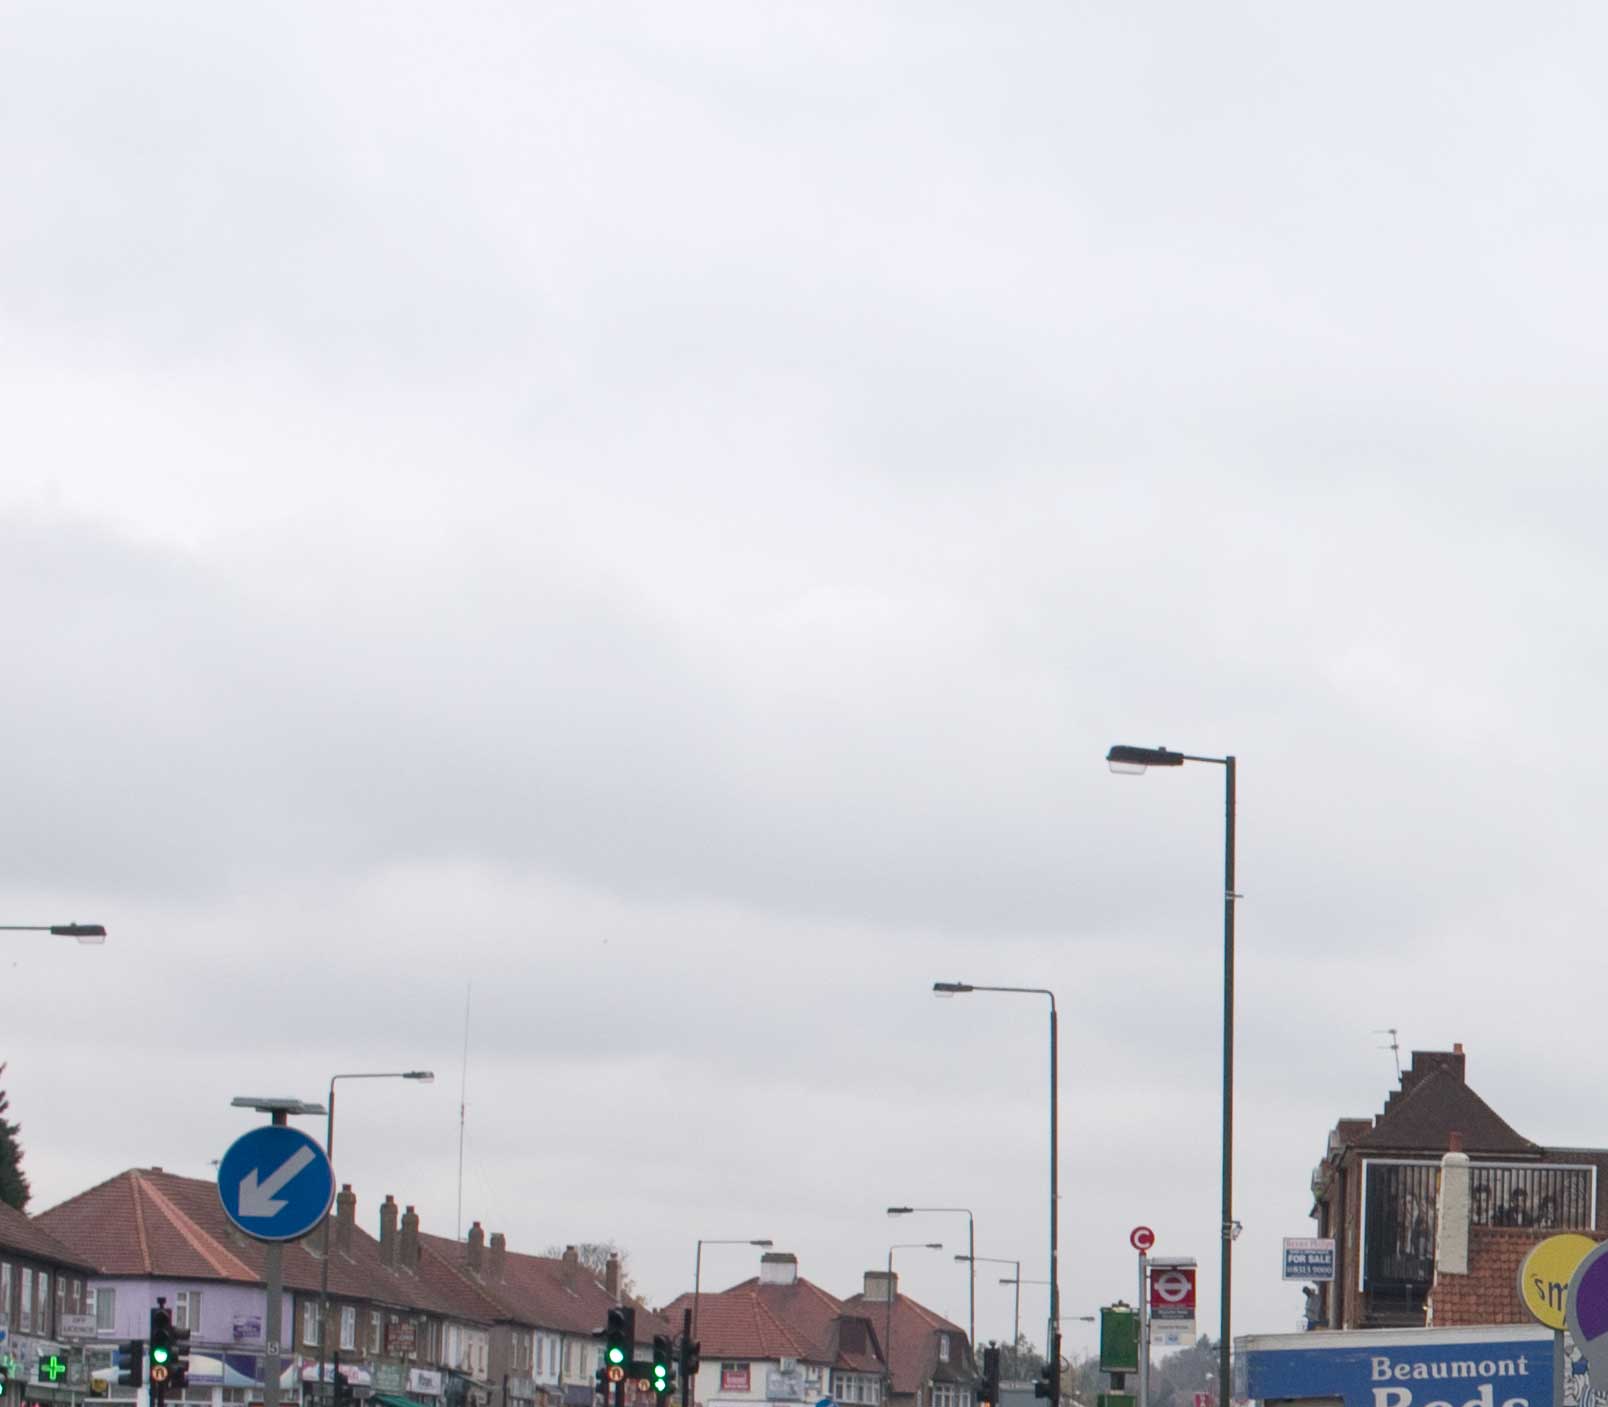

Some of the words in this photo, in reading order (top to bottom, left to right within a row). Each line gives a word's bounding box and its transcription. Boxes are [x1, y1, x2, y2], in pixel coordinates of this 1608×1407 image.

[1288, 1255, 1306, 1263] FOR
[1308, 1255, 1331, 1263] SALE
[1371, 1355, 1529, 1381] Beaumont
